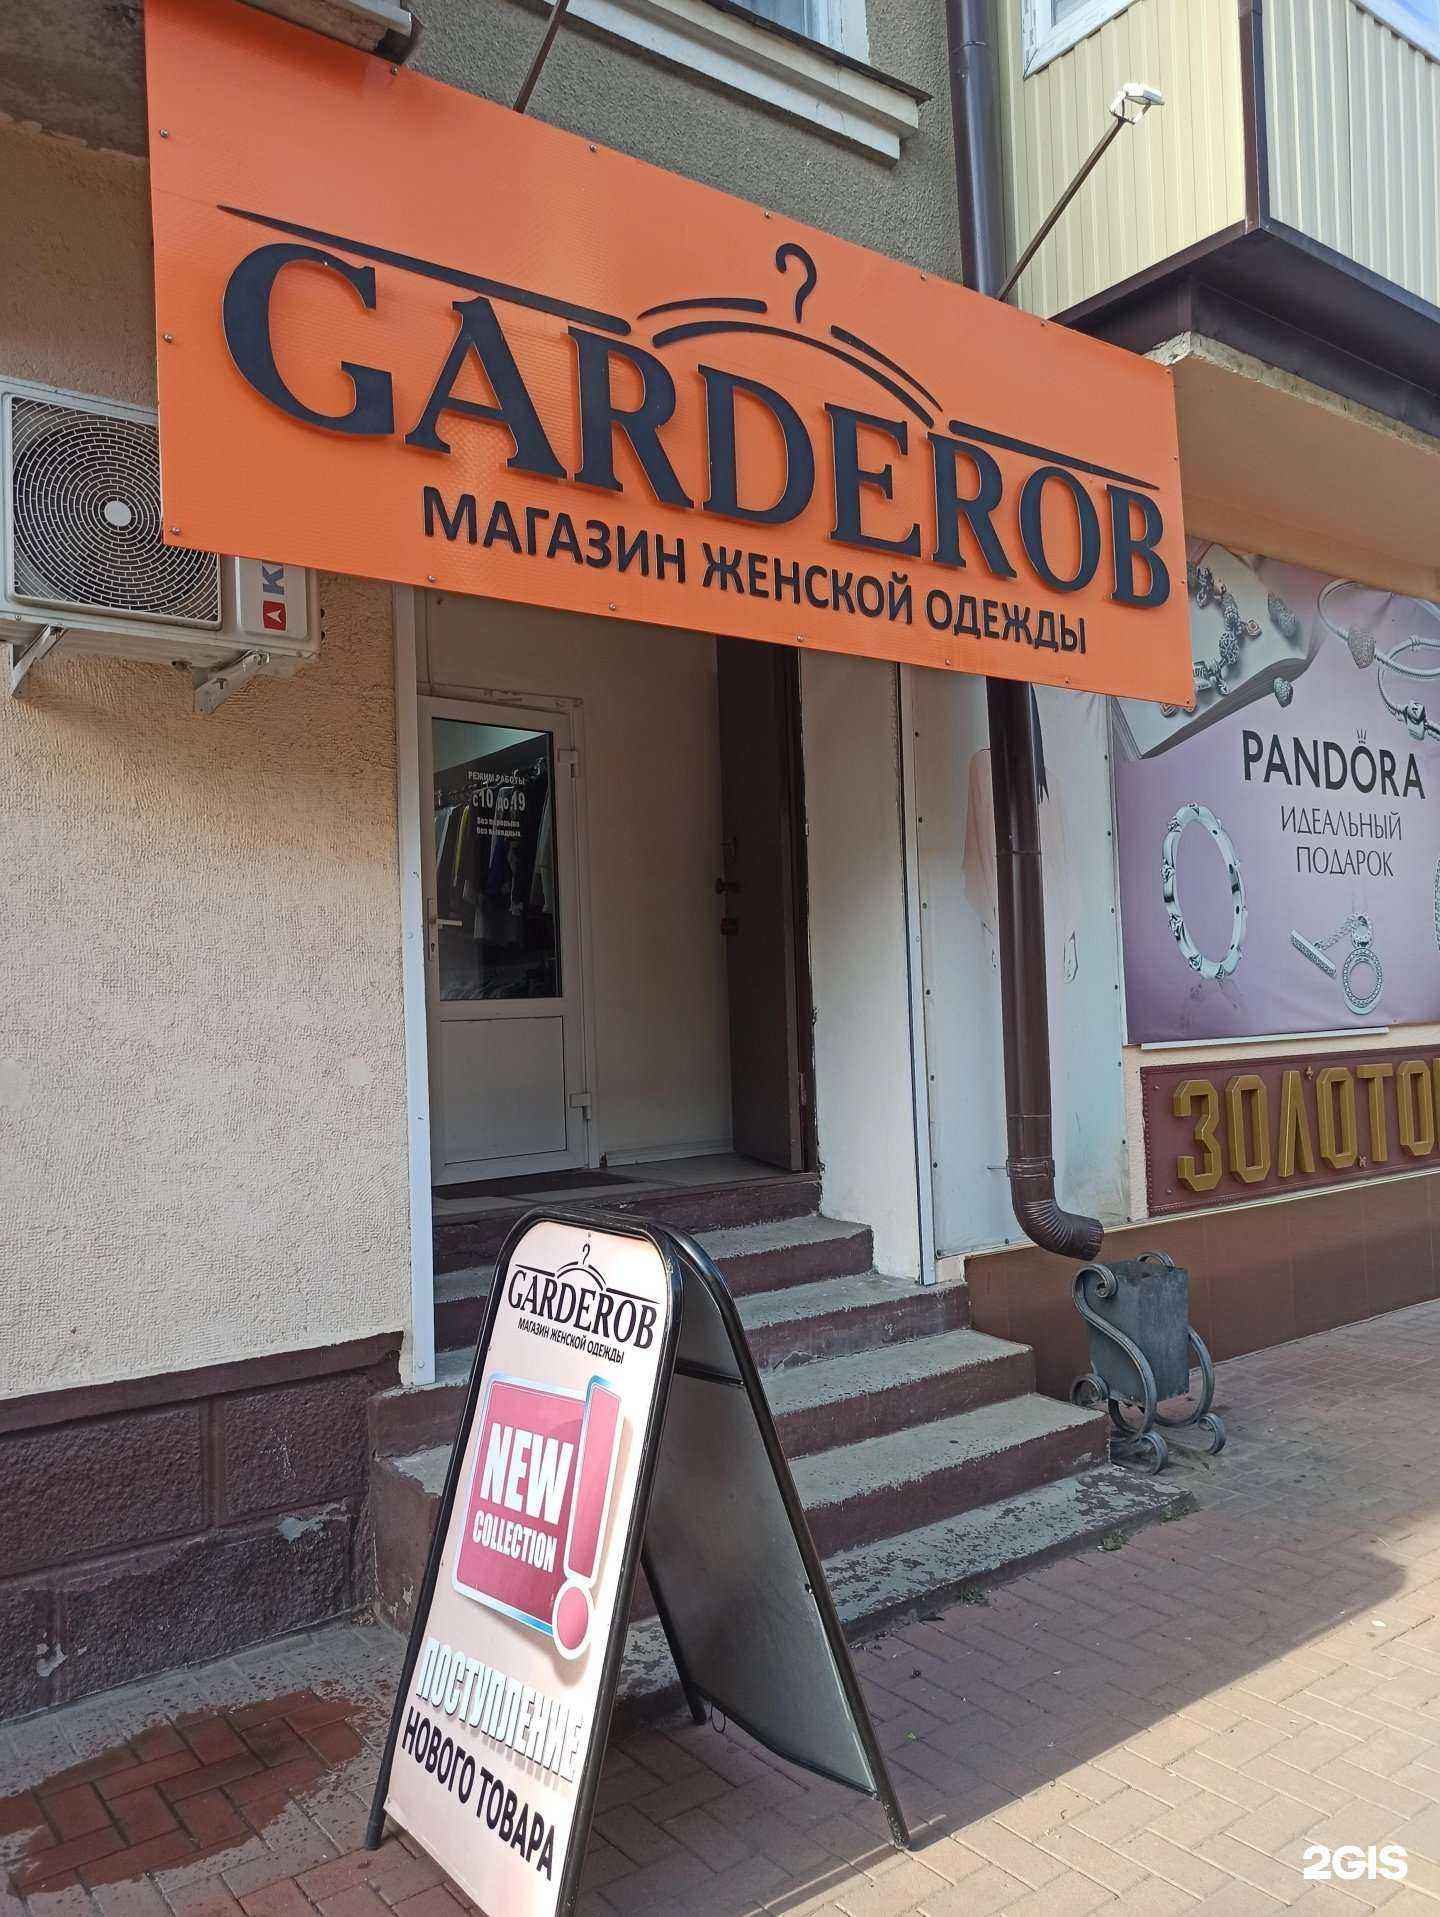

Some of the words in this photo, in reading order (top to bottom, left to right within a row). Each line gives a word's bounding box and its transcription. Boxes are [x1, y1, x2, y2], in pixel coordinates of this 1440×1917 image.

[222, 243, 1171, 607] GARDEROB
[423, 485, 686, 584] МАГАЗИН
[701, 541, 914, 625] ЖЕНСКОЙ
[925, 589, 1087, 654] ОДЕЖДЫ
[468, 771, 495, 783] РЕЖИМ
[495, 774, 526, 785] РАБОТЫ
[1242, 729, 1426, 800] PANDORA
[1281, 805, 1402, 841] ИДЕАЛЬНЫЙ
[1296, 846, 1394, 877] ПОДАРОК
[1173, 1057, 1440, 1192] ЗОЛОТО
[507, 1270, 658, 1349] GARDEROB
[518, 1317, 550, 1337] МАГАЗИН
[549, 1327, 588, 1350] ЖЕНСКОЙ
[587, 1341, 625, 1364] ОДЕЖДЫ
[479, 1422, 575, 1525] NEW
[472, 1510, 558, 1573] COLLECTION
[416, 1636, 584, 1783] ПОСТУПЛЕНИЕ
[402, 1705, 476, 1804] НОВОГО
[476, 1766, 555, 1882] ТОВАРА
